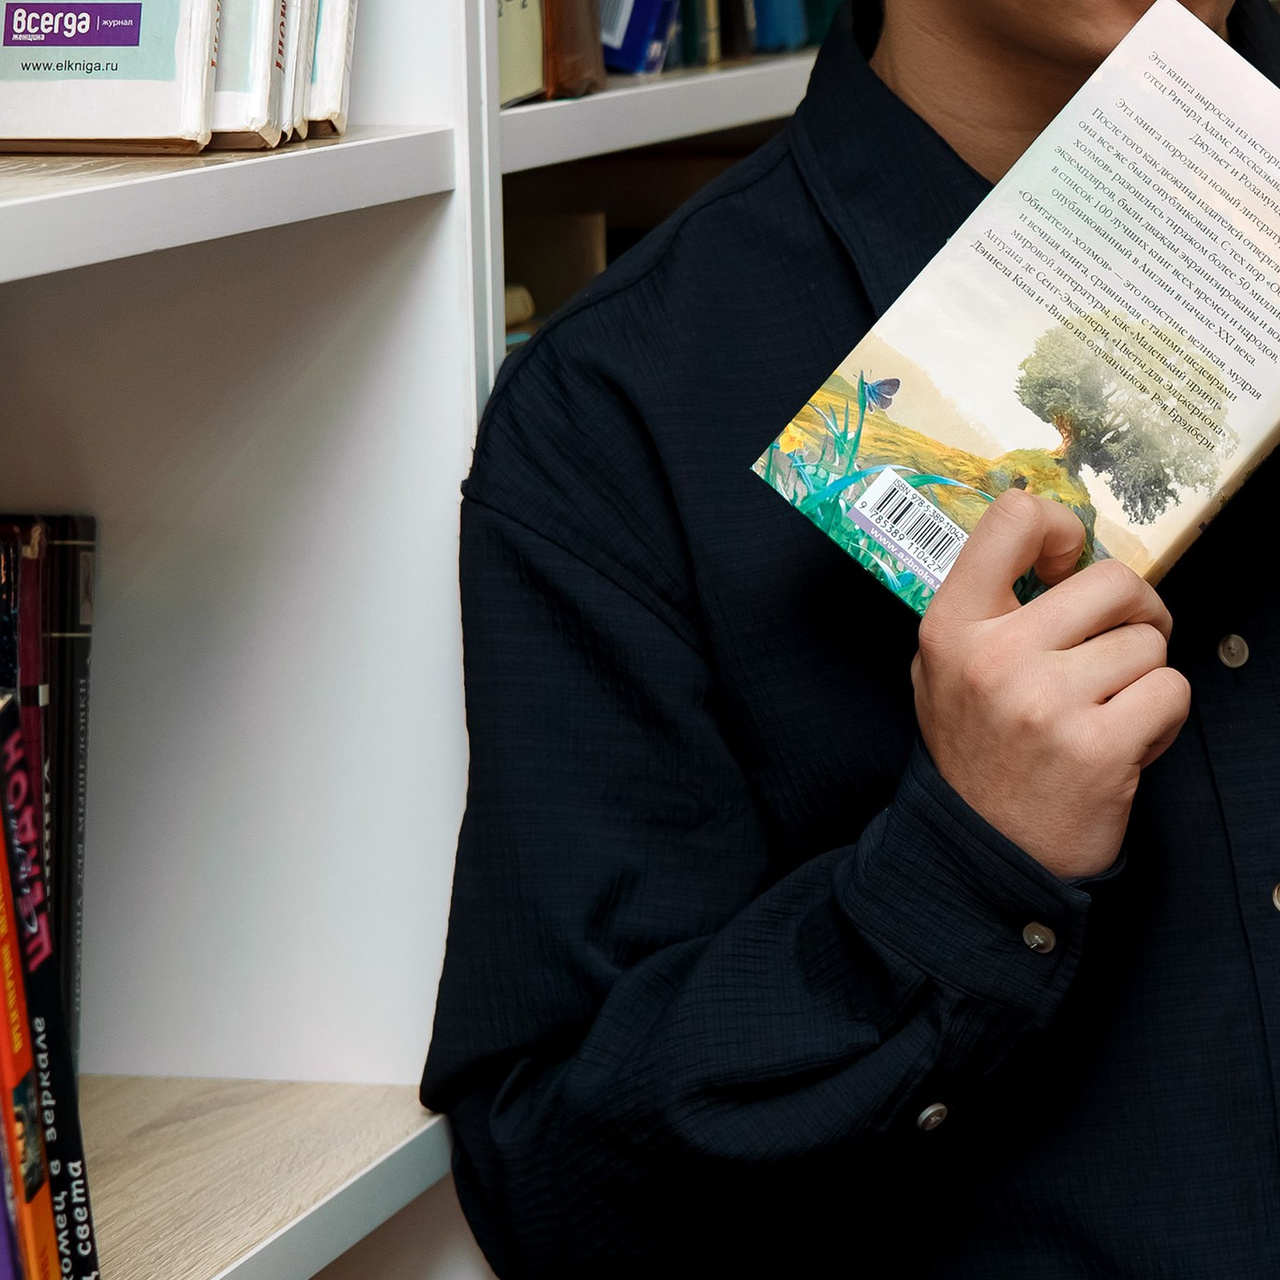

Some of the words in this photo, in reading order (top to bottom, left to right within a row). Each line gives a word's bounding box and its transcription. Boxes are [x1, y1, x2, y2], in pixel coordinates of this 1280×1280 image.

[21, 59, 118, 74] www.elkniga.ru
[101, 19, 133, 28] журнал
[1143, 71, 1167, 94] отец
[1167, 89, 1202, 124] Ричард
[1200, 120, 1232, 148] Адамс
[1148, 50, 1166, 70] Эта
[1166, 68, 1195, 94] книга
[1194, 92, 1235, 129] выросла
[1234, 126, 1248, 139] из
[1091, 107, 1121, 136] После
[1121, 133, 1143, 154] того
[1141, 152, 1159, 168] как
[1155, 163, 1197, 201] дюжина
[1196, 198, 1243, 240] издателей
[1115, 97, 1134, 117] Эта
[1133, 115, 1162, 141] книга
[1161, 139, 1208, 181] породила
[1207, 178, 1240, 208] новый
[1188, 132, 1231, 169] Джульет
[1018, 190, 1073, 238] «Обитатели
[1072, 235, 1112, 270] холмов»
[1123, 279, 1141, 296] это
[1140, 294, 1188, 336] поистине
[1186, 334, 1225, 372] великая,
[1226, 368, 1262, 400] мудрая
[969, 239, 1012, 277] Дэниела
[1011, 273, 1036, 297] Киза
[1044, 303, 1074, 330] «Вино
[1073, 328, 1087, 341] из
[1086, 339, 1150, 394] одуванчиков»
[1150, 392, 1168, 411] Рэя
[1167, 407, 1220, 453] Брэдбери.
[891, 477, 911, 496] ISBN
[857, 499, 868, 511] 9
[868, 510, 906, 543] 785389
[905, 541, 942, 574] 110427
[34, 1016, 57, 1143] зеркале
[67, 1159, 92, 1256] света
